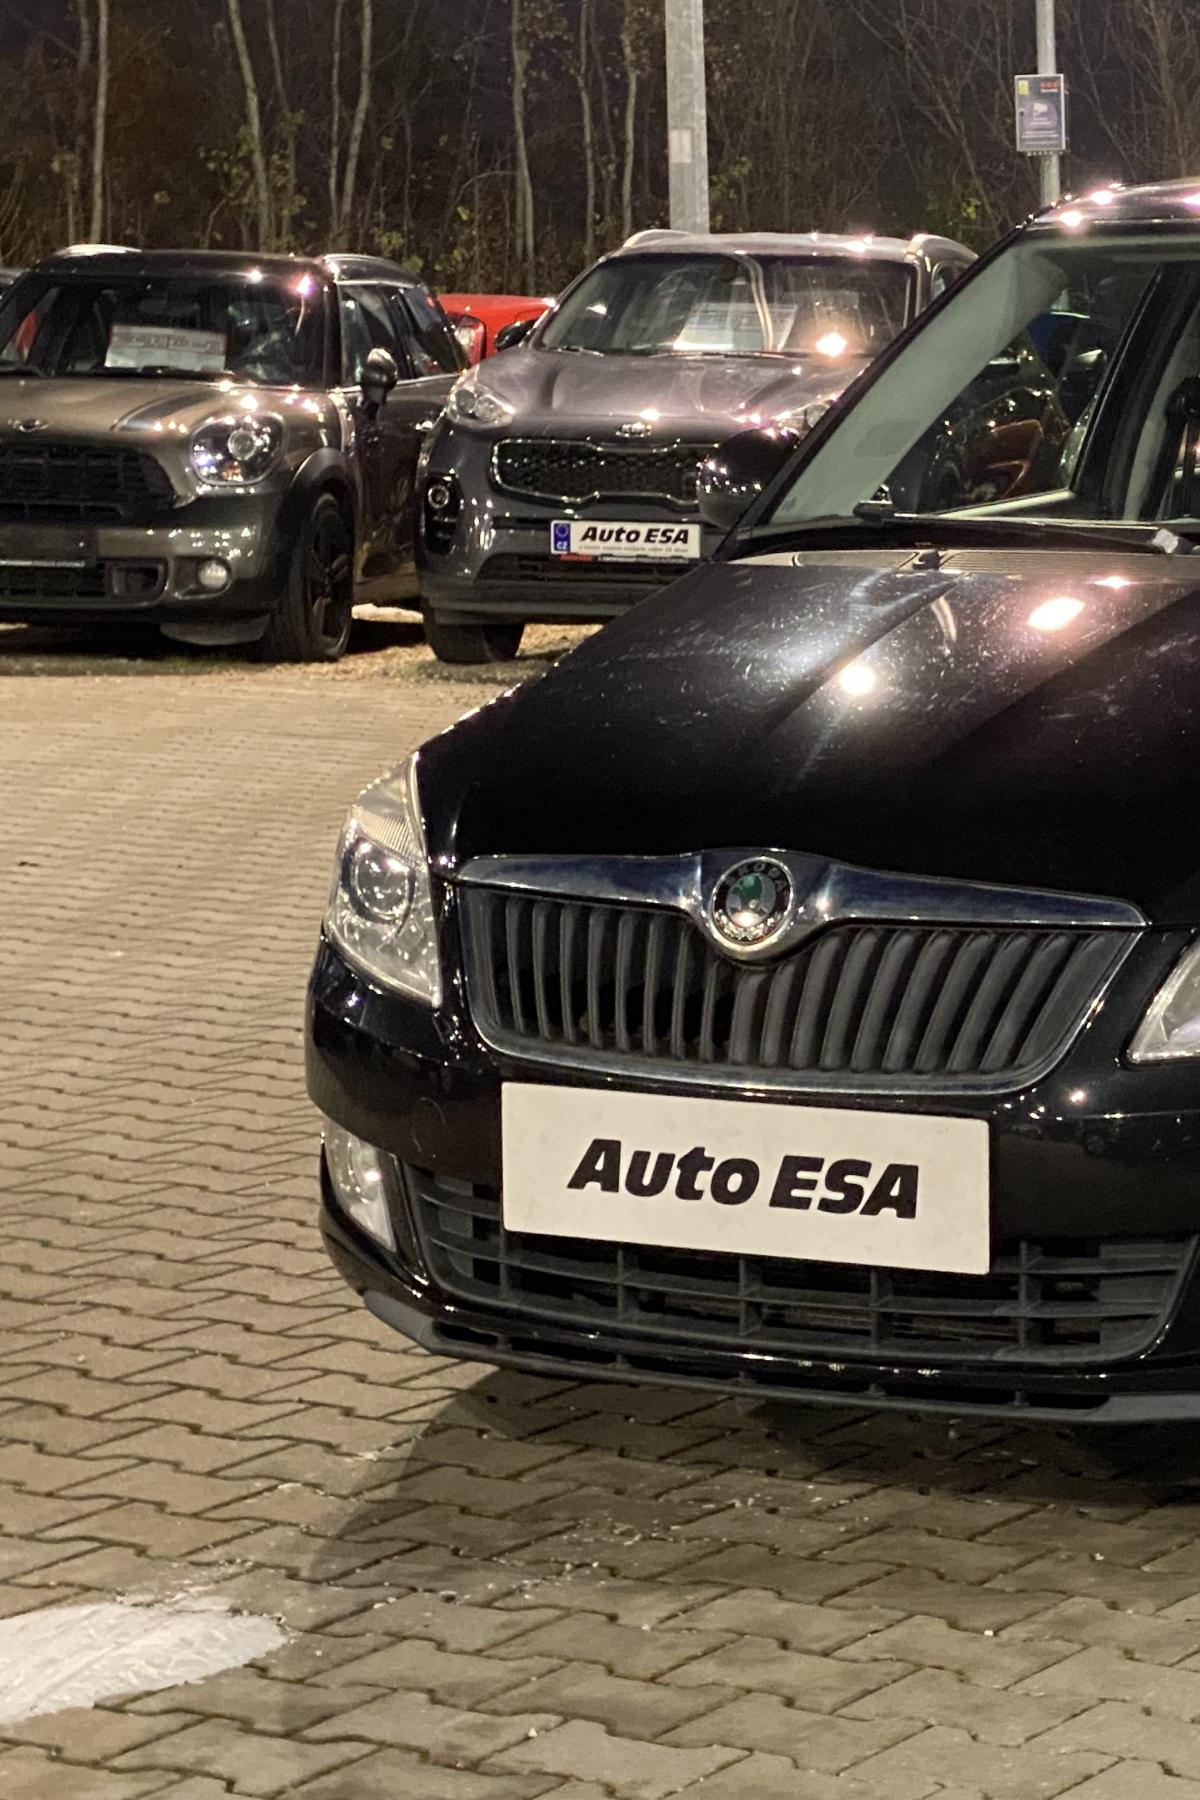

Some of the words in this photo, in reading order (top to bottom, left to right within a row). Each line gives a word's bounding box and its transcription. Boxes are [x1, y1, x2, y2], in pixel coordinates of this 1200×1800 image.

[580, 526, 641, 543] Auto
[644, 528, 689, 545] ESA
[556, 541, 568, 550] CZ
[566, 1138, 760, 1206] Auto
[768, 1154, 920, 1220] ESA
